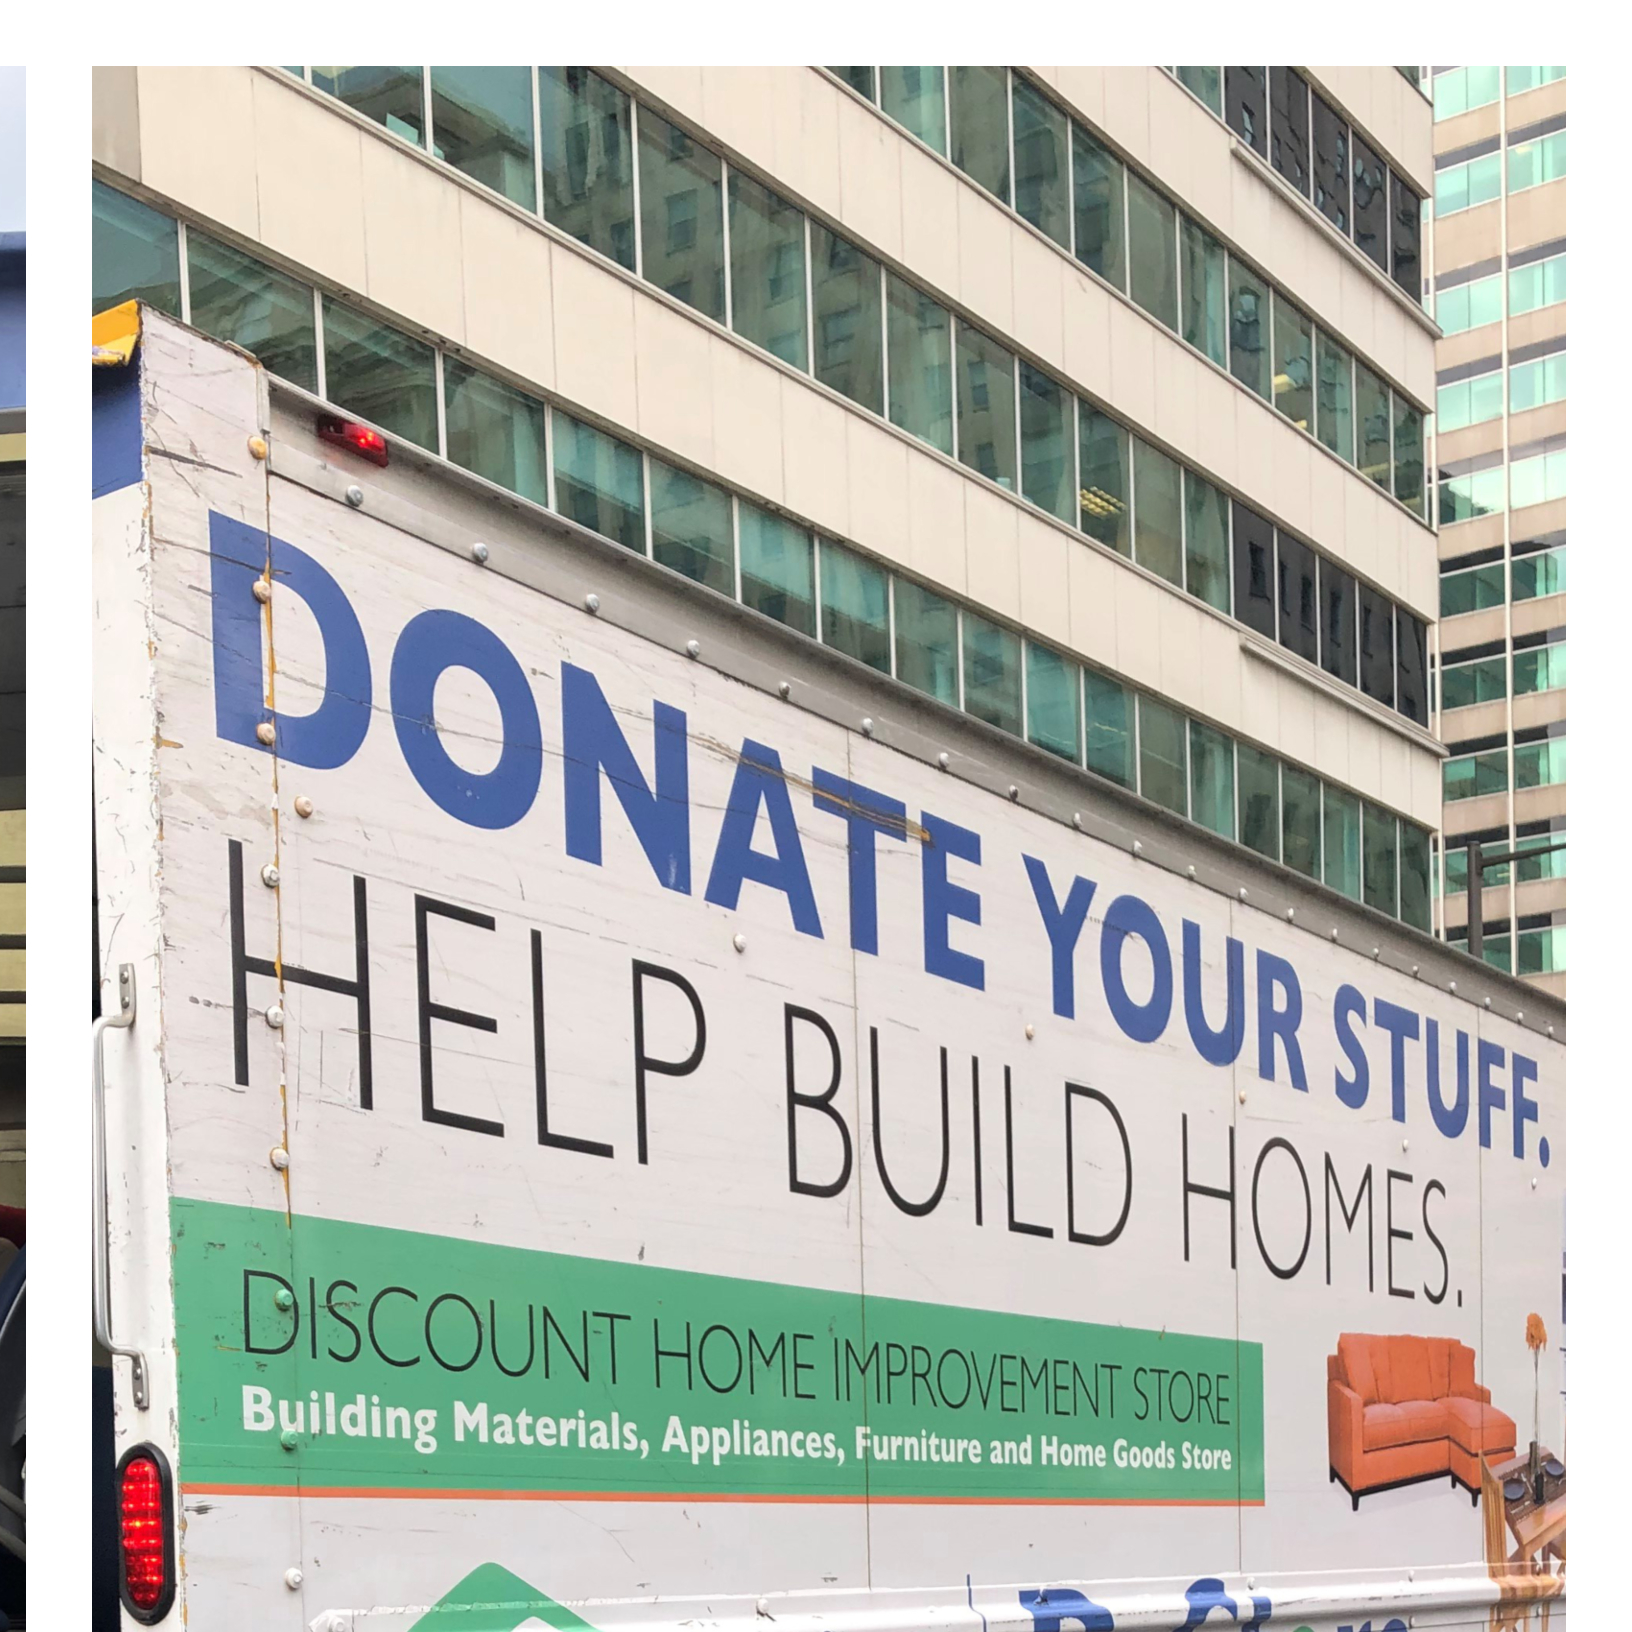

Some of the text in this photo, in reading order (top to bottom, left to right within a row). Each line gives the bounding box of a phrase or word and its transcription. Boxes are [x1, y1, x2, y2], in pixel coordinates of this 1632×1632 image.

[209, 508, 1550, 1168] DONATE YOUR STUFF.
[228, 838, 1462, 1307] HELP BUILD HOMES.
[242, 1384, 1232, 1470] Building Materials, Appliances, Furniture and Home Goods Store
[243, 1269, 1230, 1425] DISCOUNT HOME IMPROVEMENT STORE
